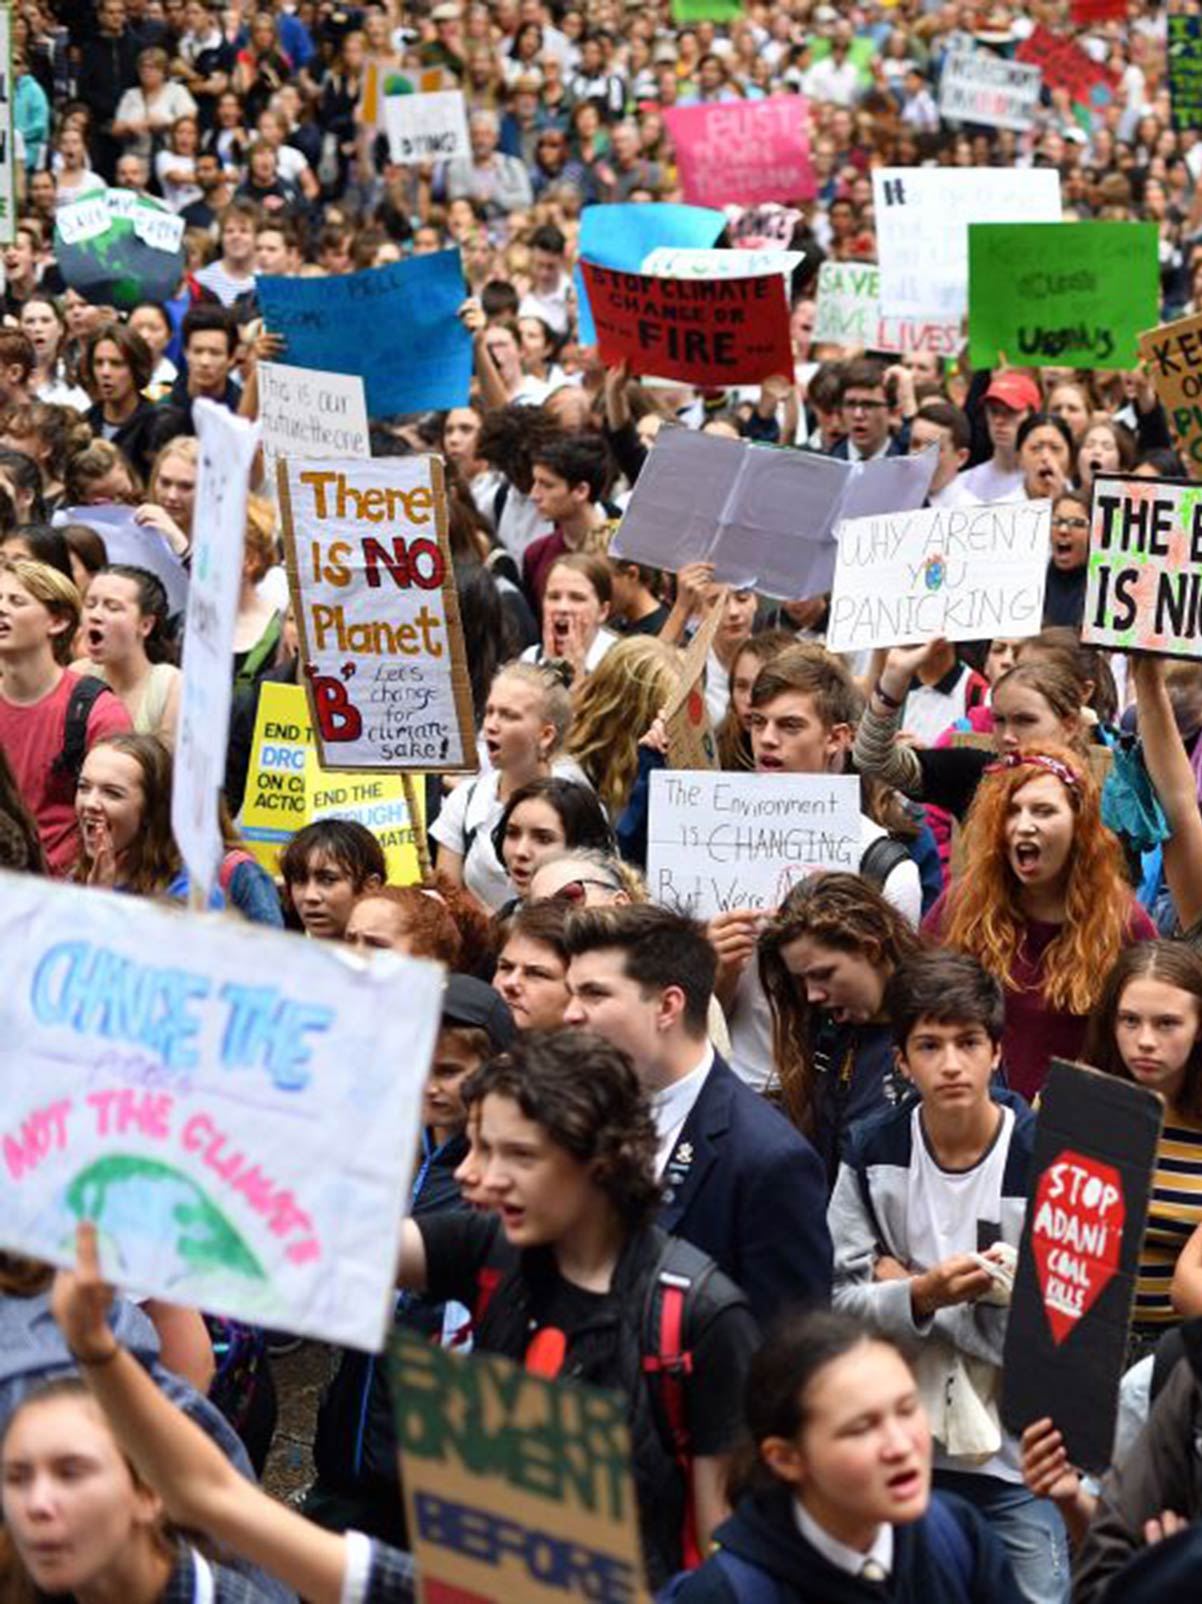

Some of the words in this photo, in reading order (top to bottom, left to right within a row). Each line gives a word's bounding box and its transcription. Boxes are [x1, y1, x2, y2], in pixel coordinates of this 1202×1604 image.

[659, 276, 769, 302] CLIMATE
[821, 266, 880, 299] SAVE
[608, 291, 703, 322] CHANGE
[637, 318, 740, 367] FIRE
[876, 318, 962, 352] LIVES
[317, 390, 349, 415] our
[299, 470, 434, 525] There
[837, 516, 903, 568] WHY
[1096, 495, 1176, 557] THE
[310, 540, 352, 588] IS
[360, 536, 447, 592] NO
[1092, 565, 1140, 632] IS
[310, 602, 443, 659] Planet
[264, 723, 300, 742] END
[385, 704, 416, 724] for
[381, 738, 450, 763] sake!
[253, 793, 306, 812] ACTIO
[257, 773, 284, 791] ON
[313, 788, 348, 808] END
[351, 781, 384, 801] THE
[664, 779, 701, 807] The
[707, 822, 853, 864] CHANGING
[659, 868, 704, 918] But
[218, 980, 337, 1093] THE
[2, 1101, 74, 1182] NOT
[86, 1088, 174, 1140] THE
[1048, 1162, 1120, 1218] STOP
[1032, 1200, 1109, 1260] ADANI
[1046, 1247, 1091, 1290] COAL
[1046, 1279, 1086, 1311] KILLS
[413, 1490, 638, 1604] BEFORE
